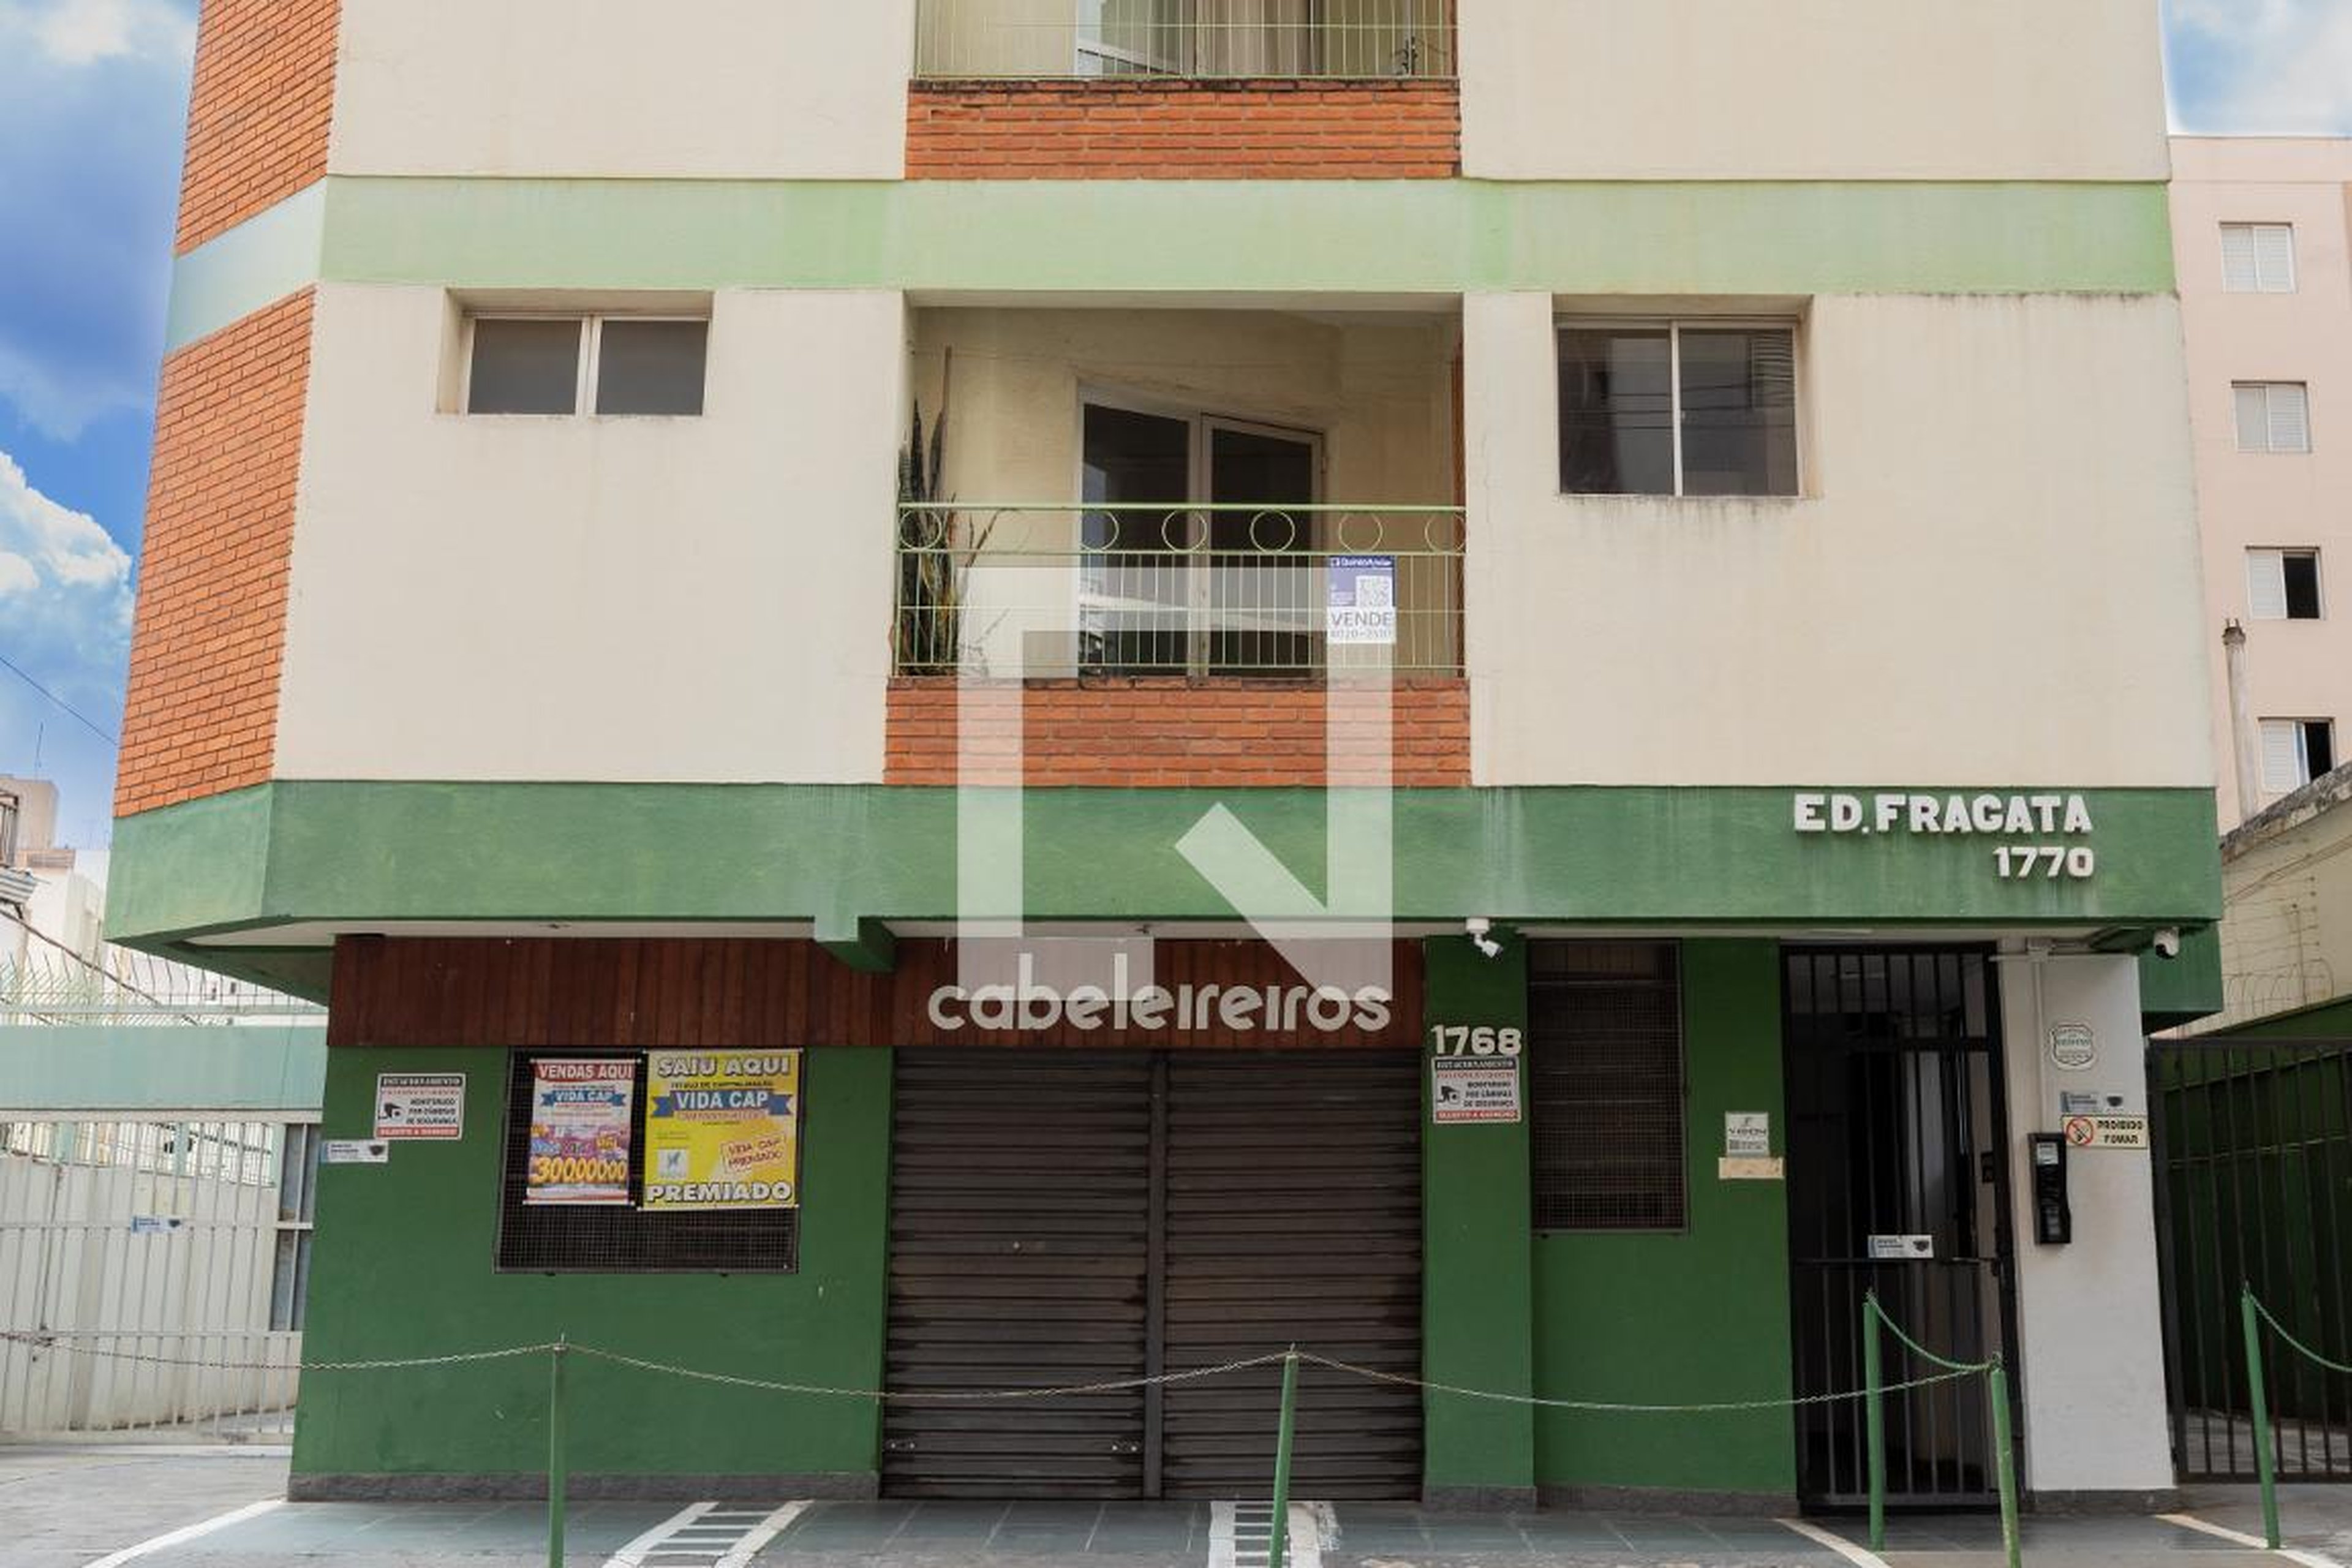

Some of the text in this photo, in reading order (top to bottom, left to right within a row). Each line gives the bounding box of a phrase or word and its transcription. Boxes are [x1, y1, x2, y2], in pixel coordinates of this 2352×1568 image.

[1330, 612, 1393, 626] VENDE
[1992, 846, 2094, 878] 1770
[927, 953, 1392, 1031] cabeleireiros
[1430, 1025, 1521, 1055] 1768
[538, 1065, 633, 1079] VENDAS AQUI
[658, 1057, 790, 1077] SAIU AQUI
[555, 1091, 612, 1101] VIDA CAP
[676, 1091, 768, 1109] VIDA CAP
[646, 1181, 793, 1202] PREMIADO
